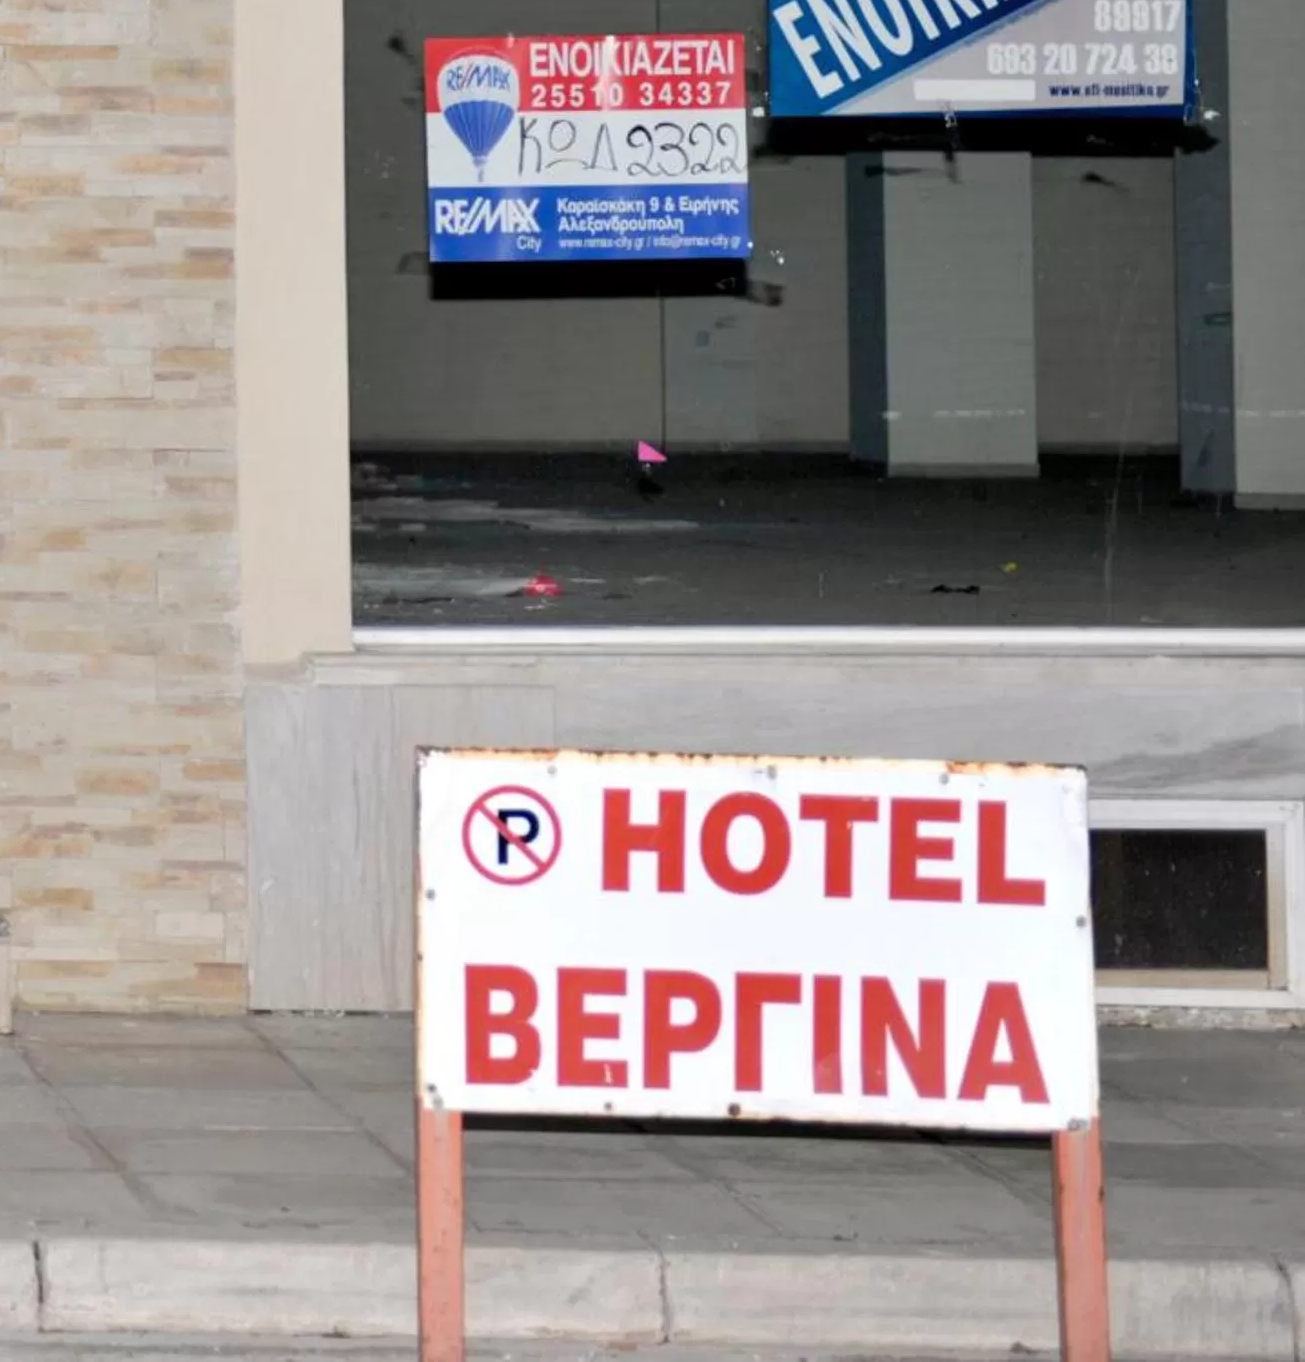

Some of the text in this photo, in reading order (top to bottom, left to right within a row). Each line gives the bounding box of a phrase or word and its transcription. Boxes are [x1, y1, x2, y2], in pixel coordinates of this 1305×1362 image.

[529, 38, 735, 78] ΕΝΟΙΚΙΑΖΕΤΑΙ
[1043, 42, 1078, 76] 20
[1083, 42, 1139, 76] 724
[446, 62, 512, 92] RE/MAX
[531, 81, 732, 108] 25510 34337
[434, 197, 542, 235] RE/MAX
[649, 197, 660, 212] 9
[665, 196, 676, 212] &
[679, 196, 740, 215] Ειρήνης
[516, 235, 543, 253] City
[601, 788, 1046, 906] HOTEL
[464, 964, 1050, 1104] ΒΕΡΓΙΝΑ
